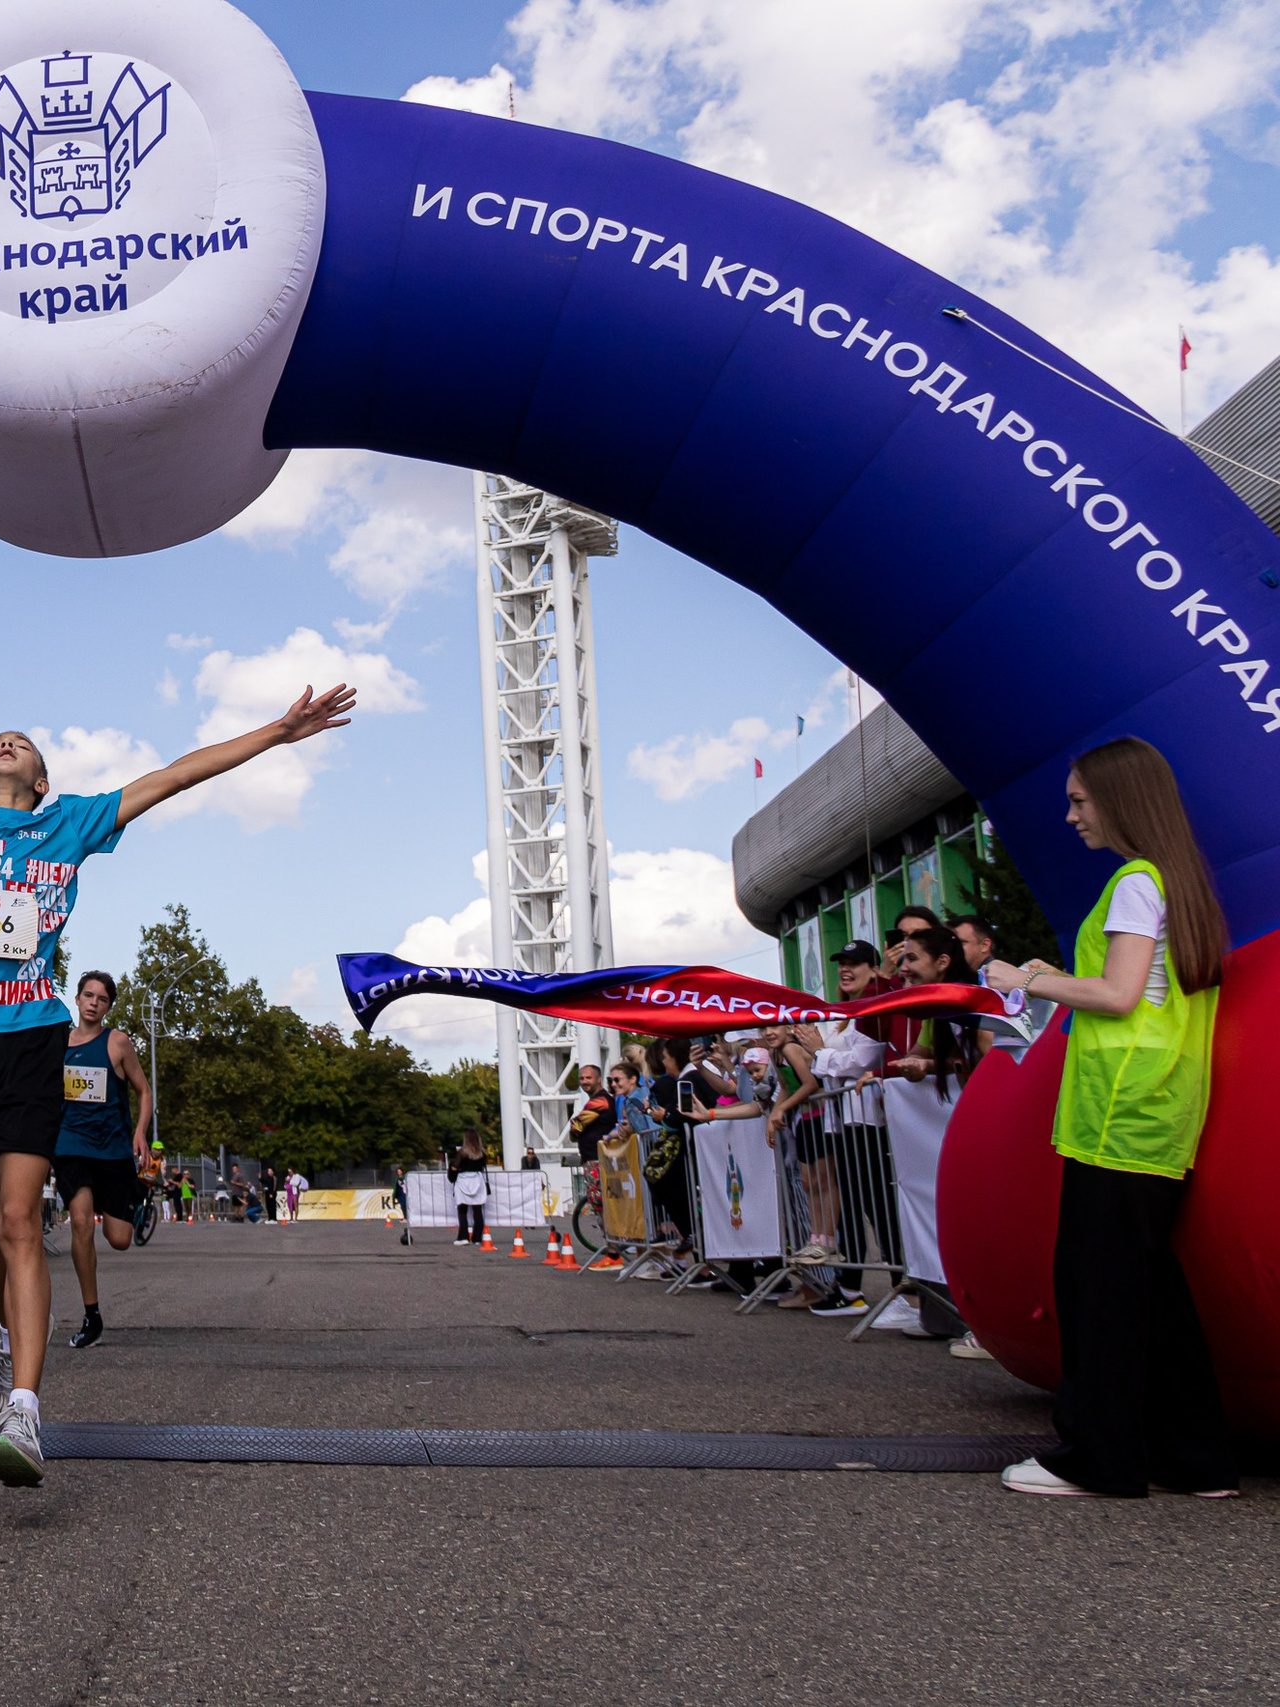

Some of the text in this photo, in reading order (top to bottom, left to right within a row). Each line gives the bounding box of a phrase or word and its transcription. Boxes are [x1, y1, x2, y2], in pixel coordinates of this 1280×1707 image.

[19, 273, 128, 324] край
[413, 184, 1280, 733] И СПОРТА КРАСНОДАРСКОГО КРАЯ
[3, 943, 27, 955] 2 КМ
[72, 1078, 94, 1090] 1335
